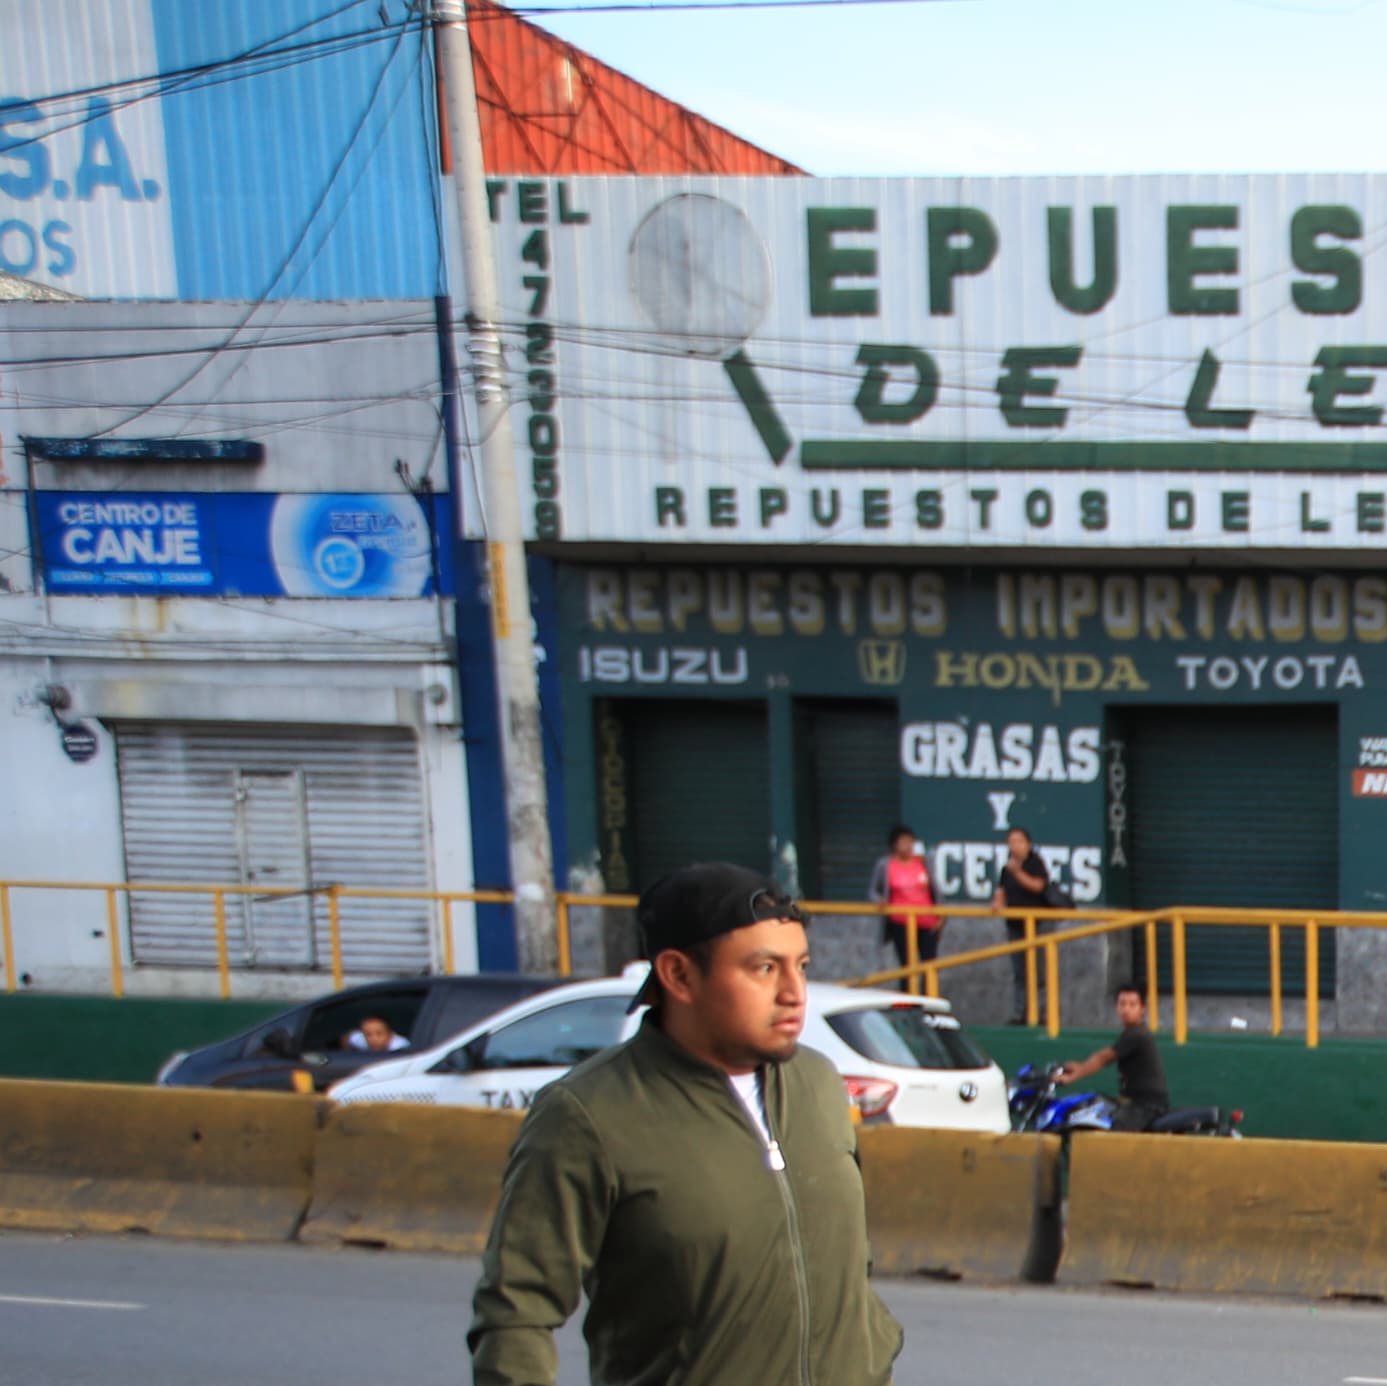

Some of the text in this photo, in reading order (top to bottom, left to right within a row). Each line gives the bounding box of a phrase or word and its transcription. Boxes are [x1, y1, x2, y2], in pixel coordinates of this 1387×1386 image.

[486, 181, 590, 225] TEL
[853, 343, 1084, 428] DE
[60, 503, 198, 526] CENTRO DE
[331, 512, 404, 532] ZETA
[655, 486, 1109, 532] REPUESTOS
[1166, 490, 1251, 532] DE
[63, 528, 202, 565] CANJE
[586, 569, 949, 637] REPUESTOS
[578, 646, 749, 684] ISUZU
[934, 651, 1149, 692] HONDA
[1177, 656, 1365, 691] TOYOTA
[901, 721, 1100, 784] GRASAS
[987, 791, 1016, 831] Y
[1108, 740, 1128, 868] TOYOTA
